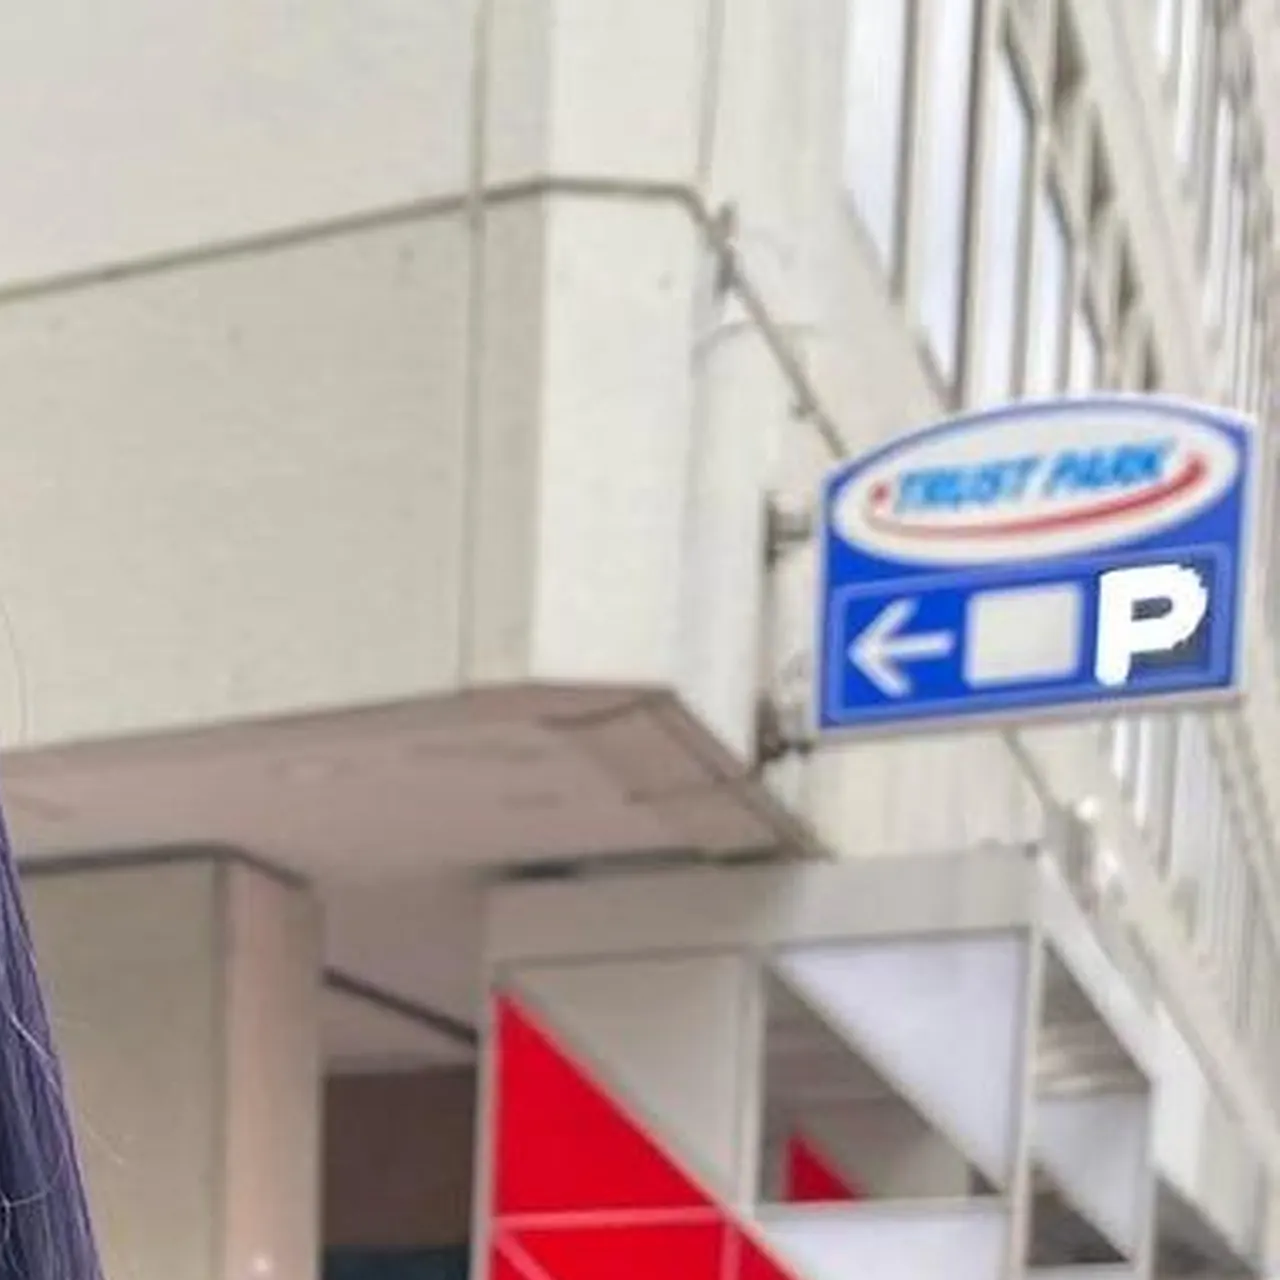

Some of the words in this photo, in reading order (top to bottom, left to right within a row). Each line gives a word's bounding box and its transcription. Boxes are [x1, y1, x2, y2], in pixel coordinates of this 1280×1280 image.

[895, 457, 1040, 514] TRUST
[1045, 439, 1174, 496] PARK
[1094, 564, 1208, 686] P
